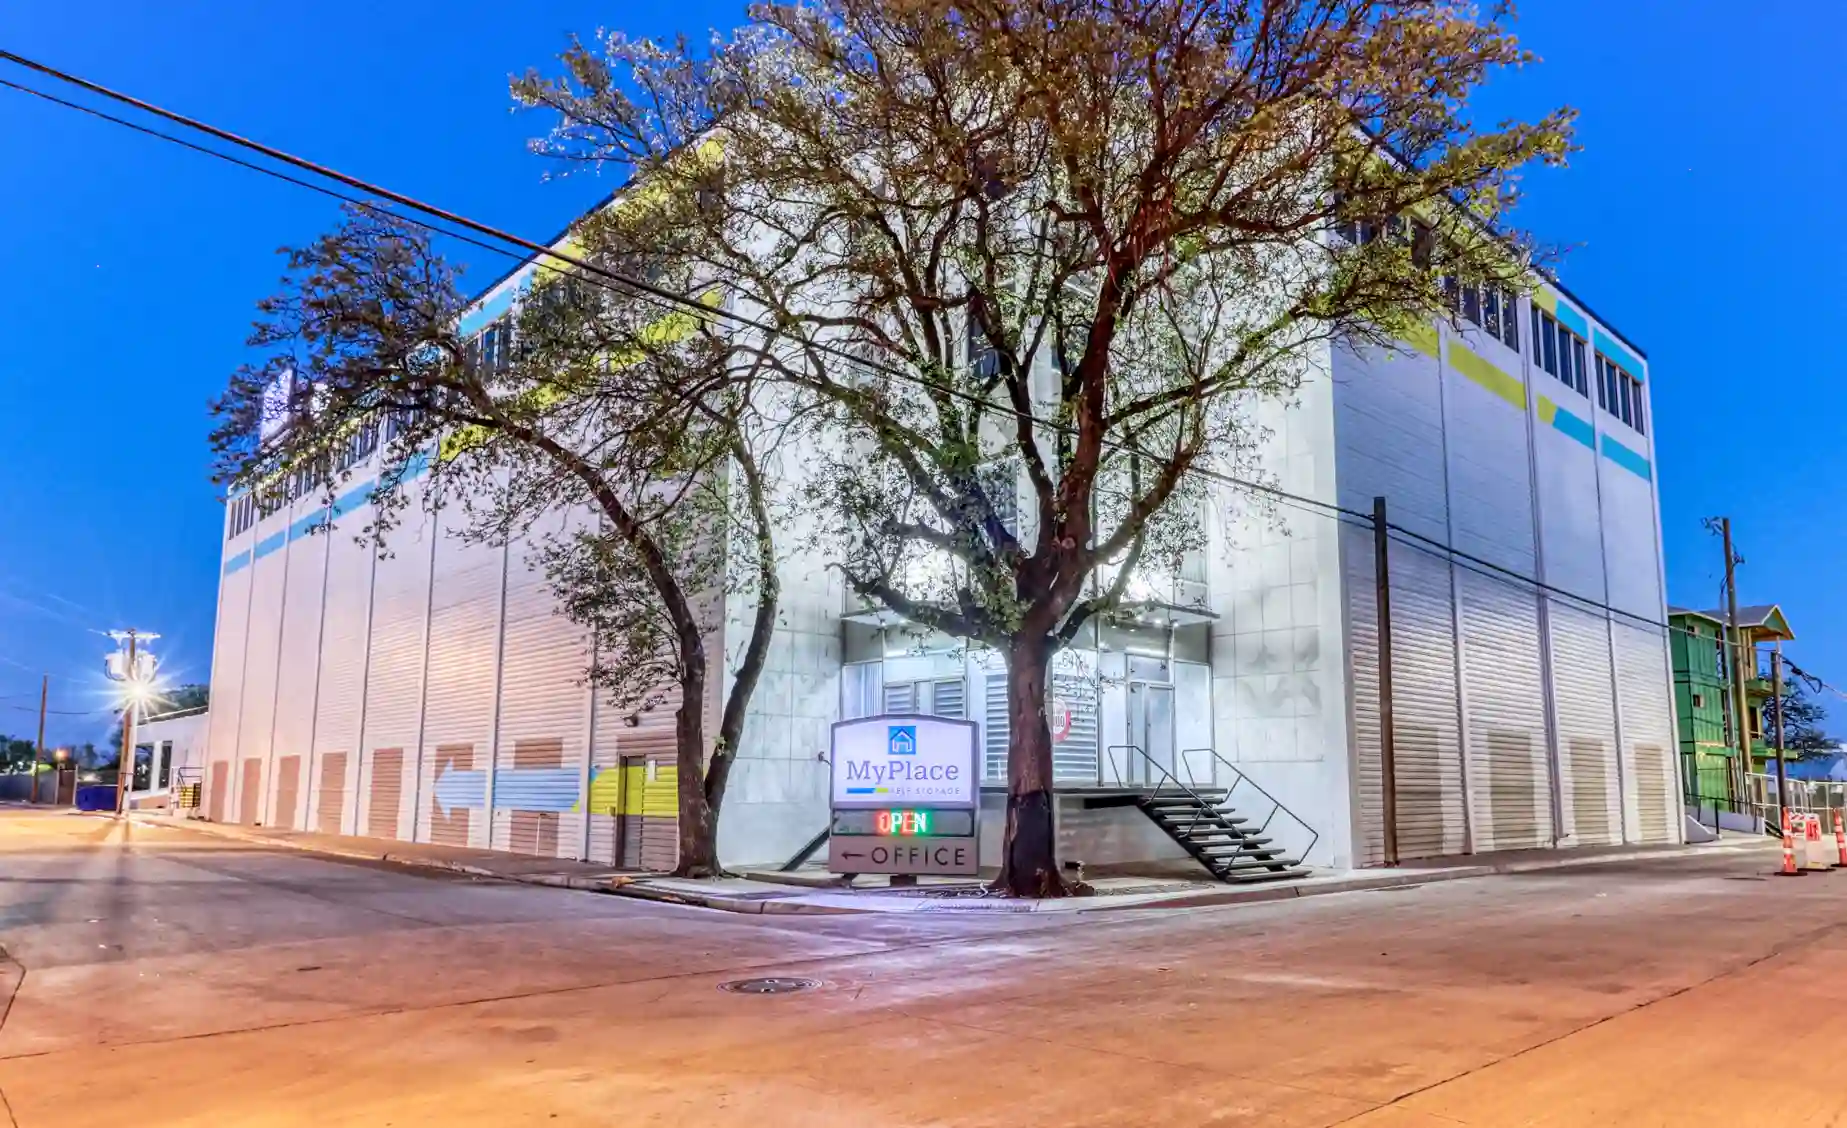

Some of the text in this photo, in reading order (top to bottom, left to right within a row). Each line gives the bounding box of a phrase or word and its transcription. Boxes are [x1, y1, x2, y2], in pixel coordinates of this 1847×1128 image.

[846, 760, 959, 785] MyPlace
[878, 812, 927, 833] OPEN
[871, 846, 965, 867] OFFICE
